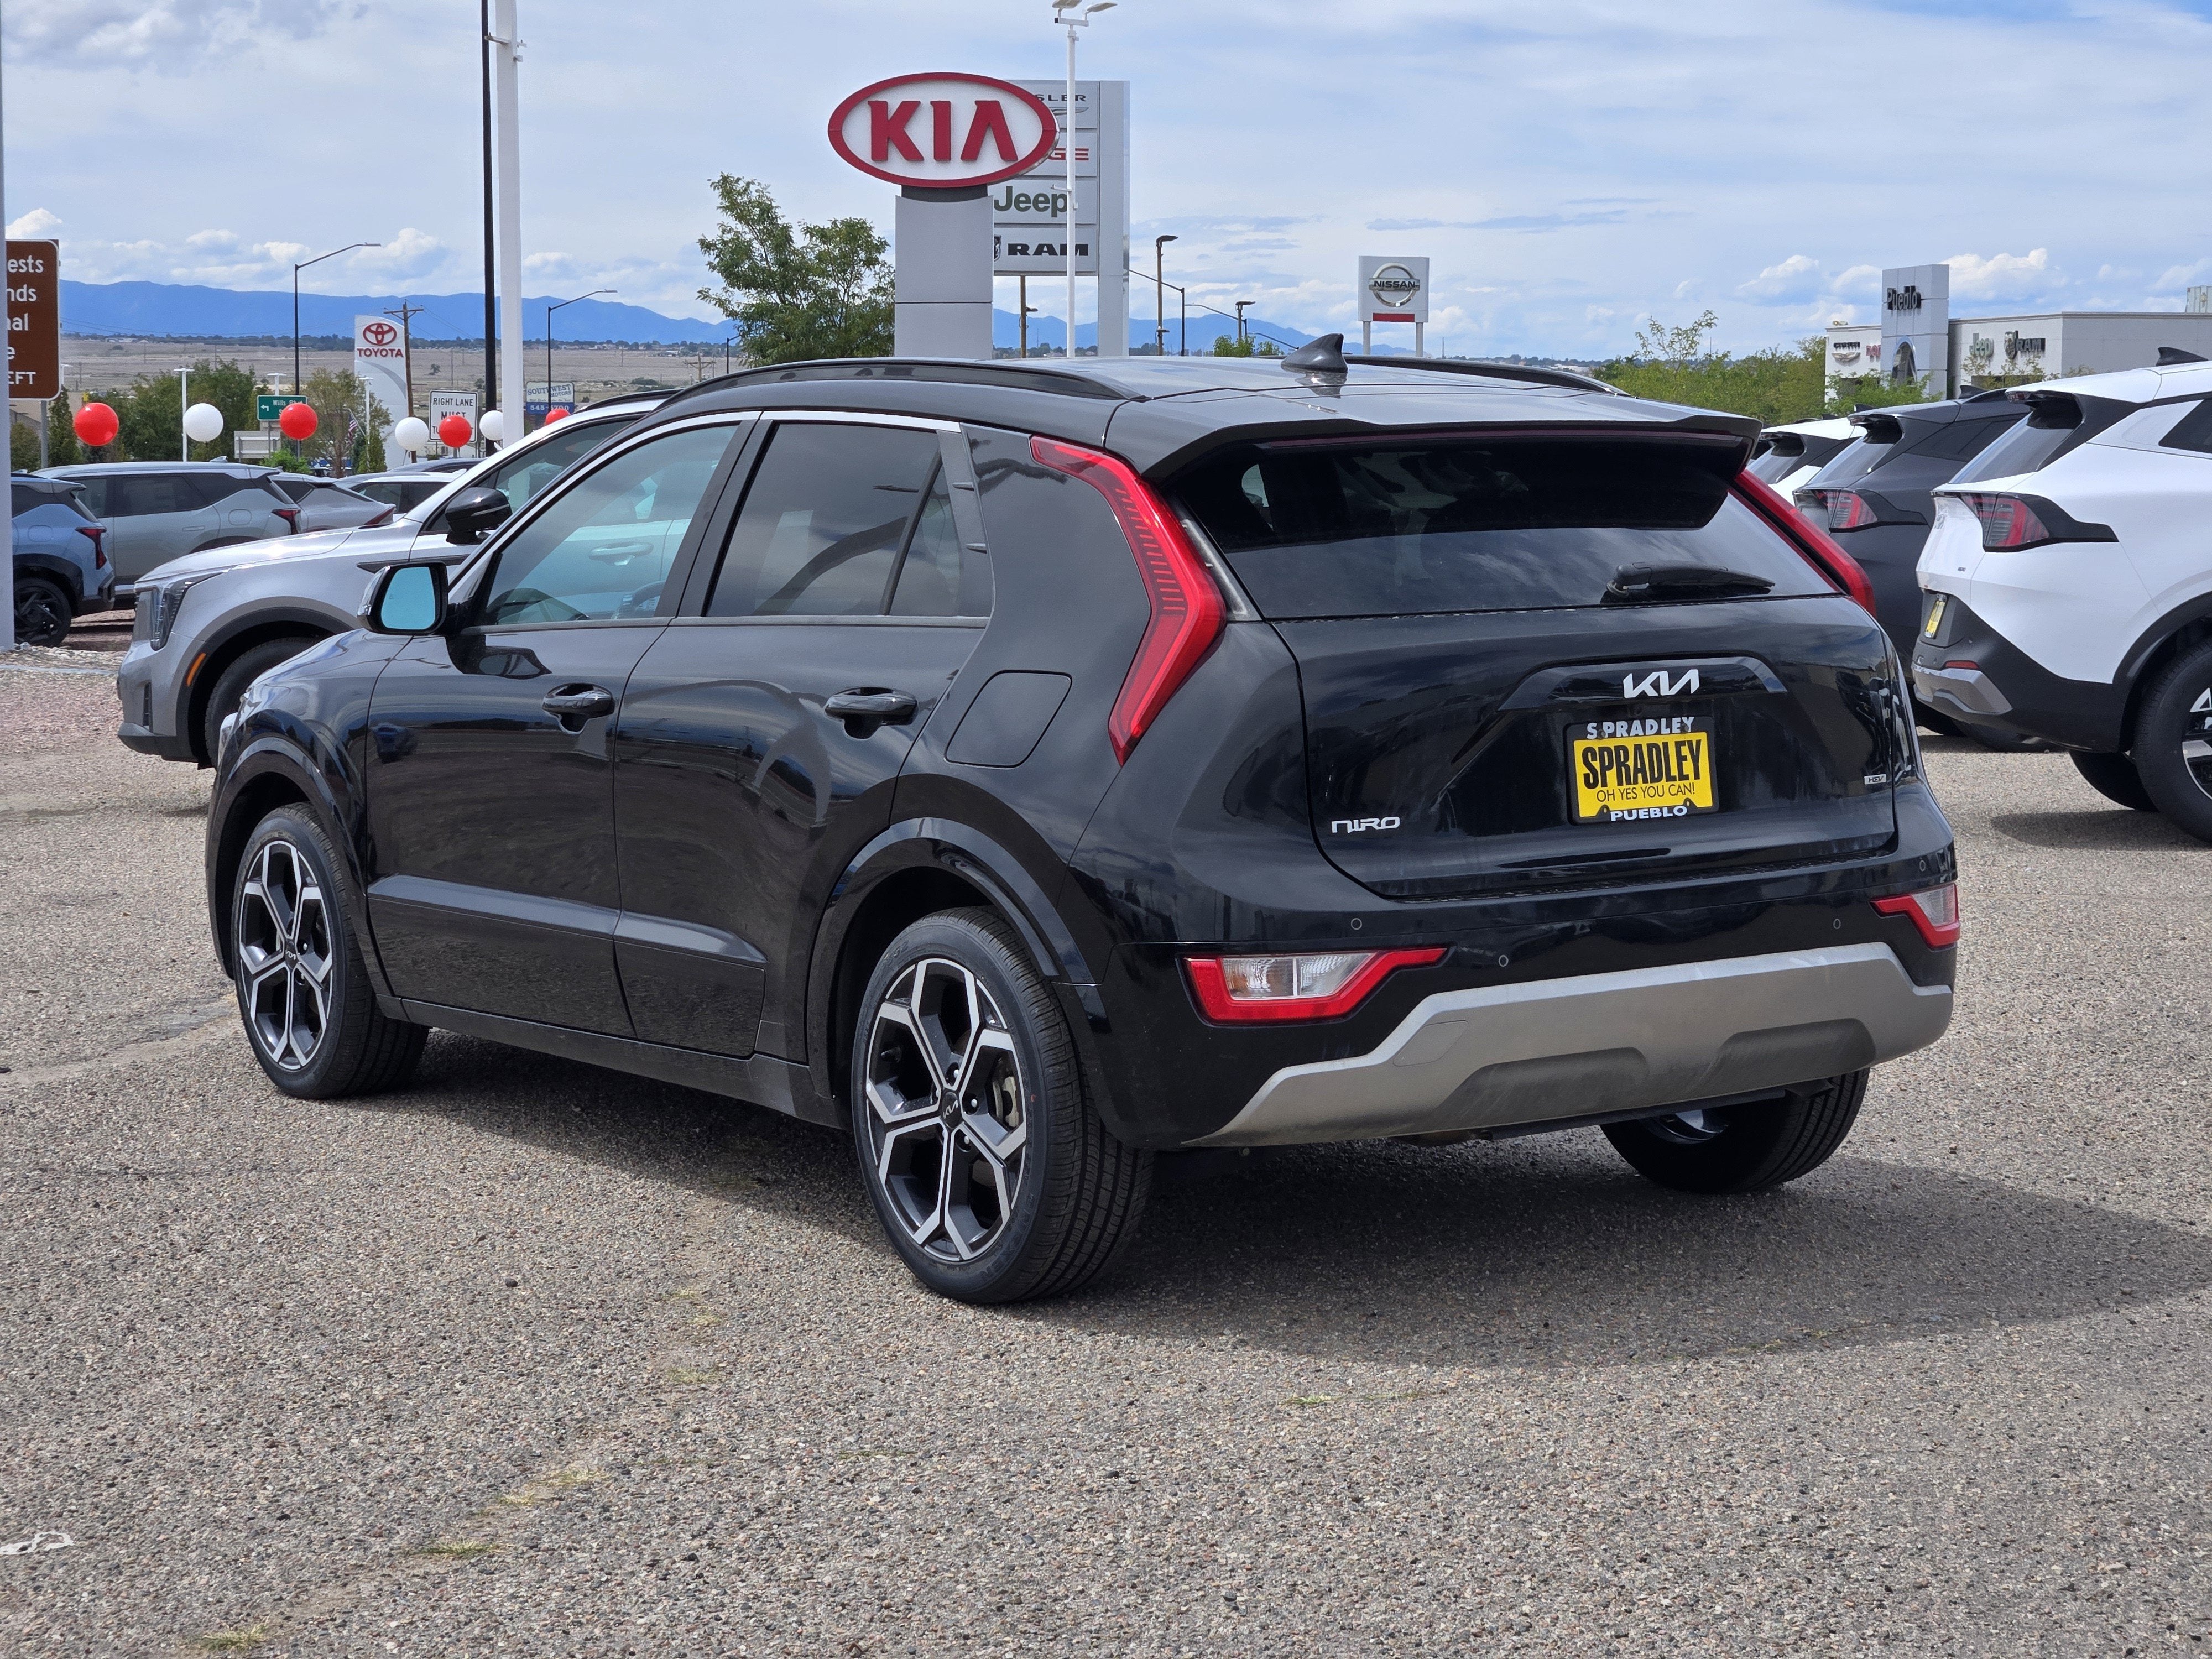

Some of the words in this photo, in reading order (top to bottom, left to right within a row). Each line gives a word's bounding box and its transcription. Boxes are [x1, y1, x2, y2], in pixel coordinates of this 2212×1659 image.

[867, 100, 1019, 161] KIA
[993, 185, 1068, 218] Jeep
[1008, 243, 1088, 257] RAM
[1886, 285, 1922, 311] Pueblo
[357, 348, 404, 358] TOYOTA
[2016, 338, 2044, 352] RAM
[432, 397, 453, 405] RIGHT
[455, 398, 473, 406] LANE
[1623, 669, 1700, 698] KIA
[1586, 716, 1695, 740] SPRADLEY
[1581, 739, 1702, 790] SPRADLEY
[1597, 789, 1615, 802] OH
[1618, 786, 1638, 800] YES
[1640, 784, 1665, 799] YOU
[1668, 782, 1695, 796] CAN!
[1610, 805, 1688, 822] PUEBLO
